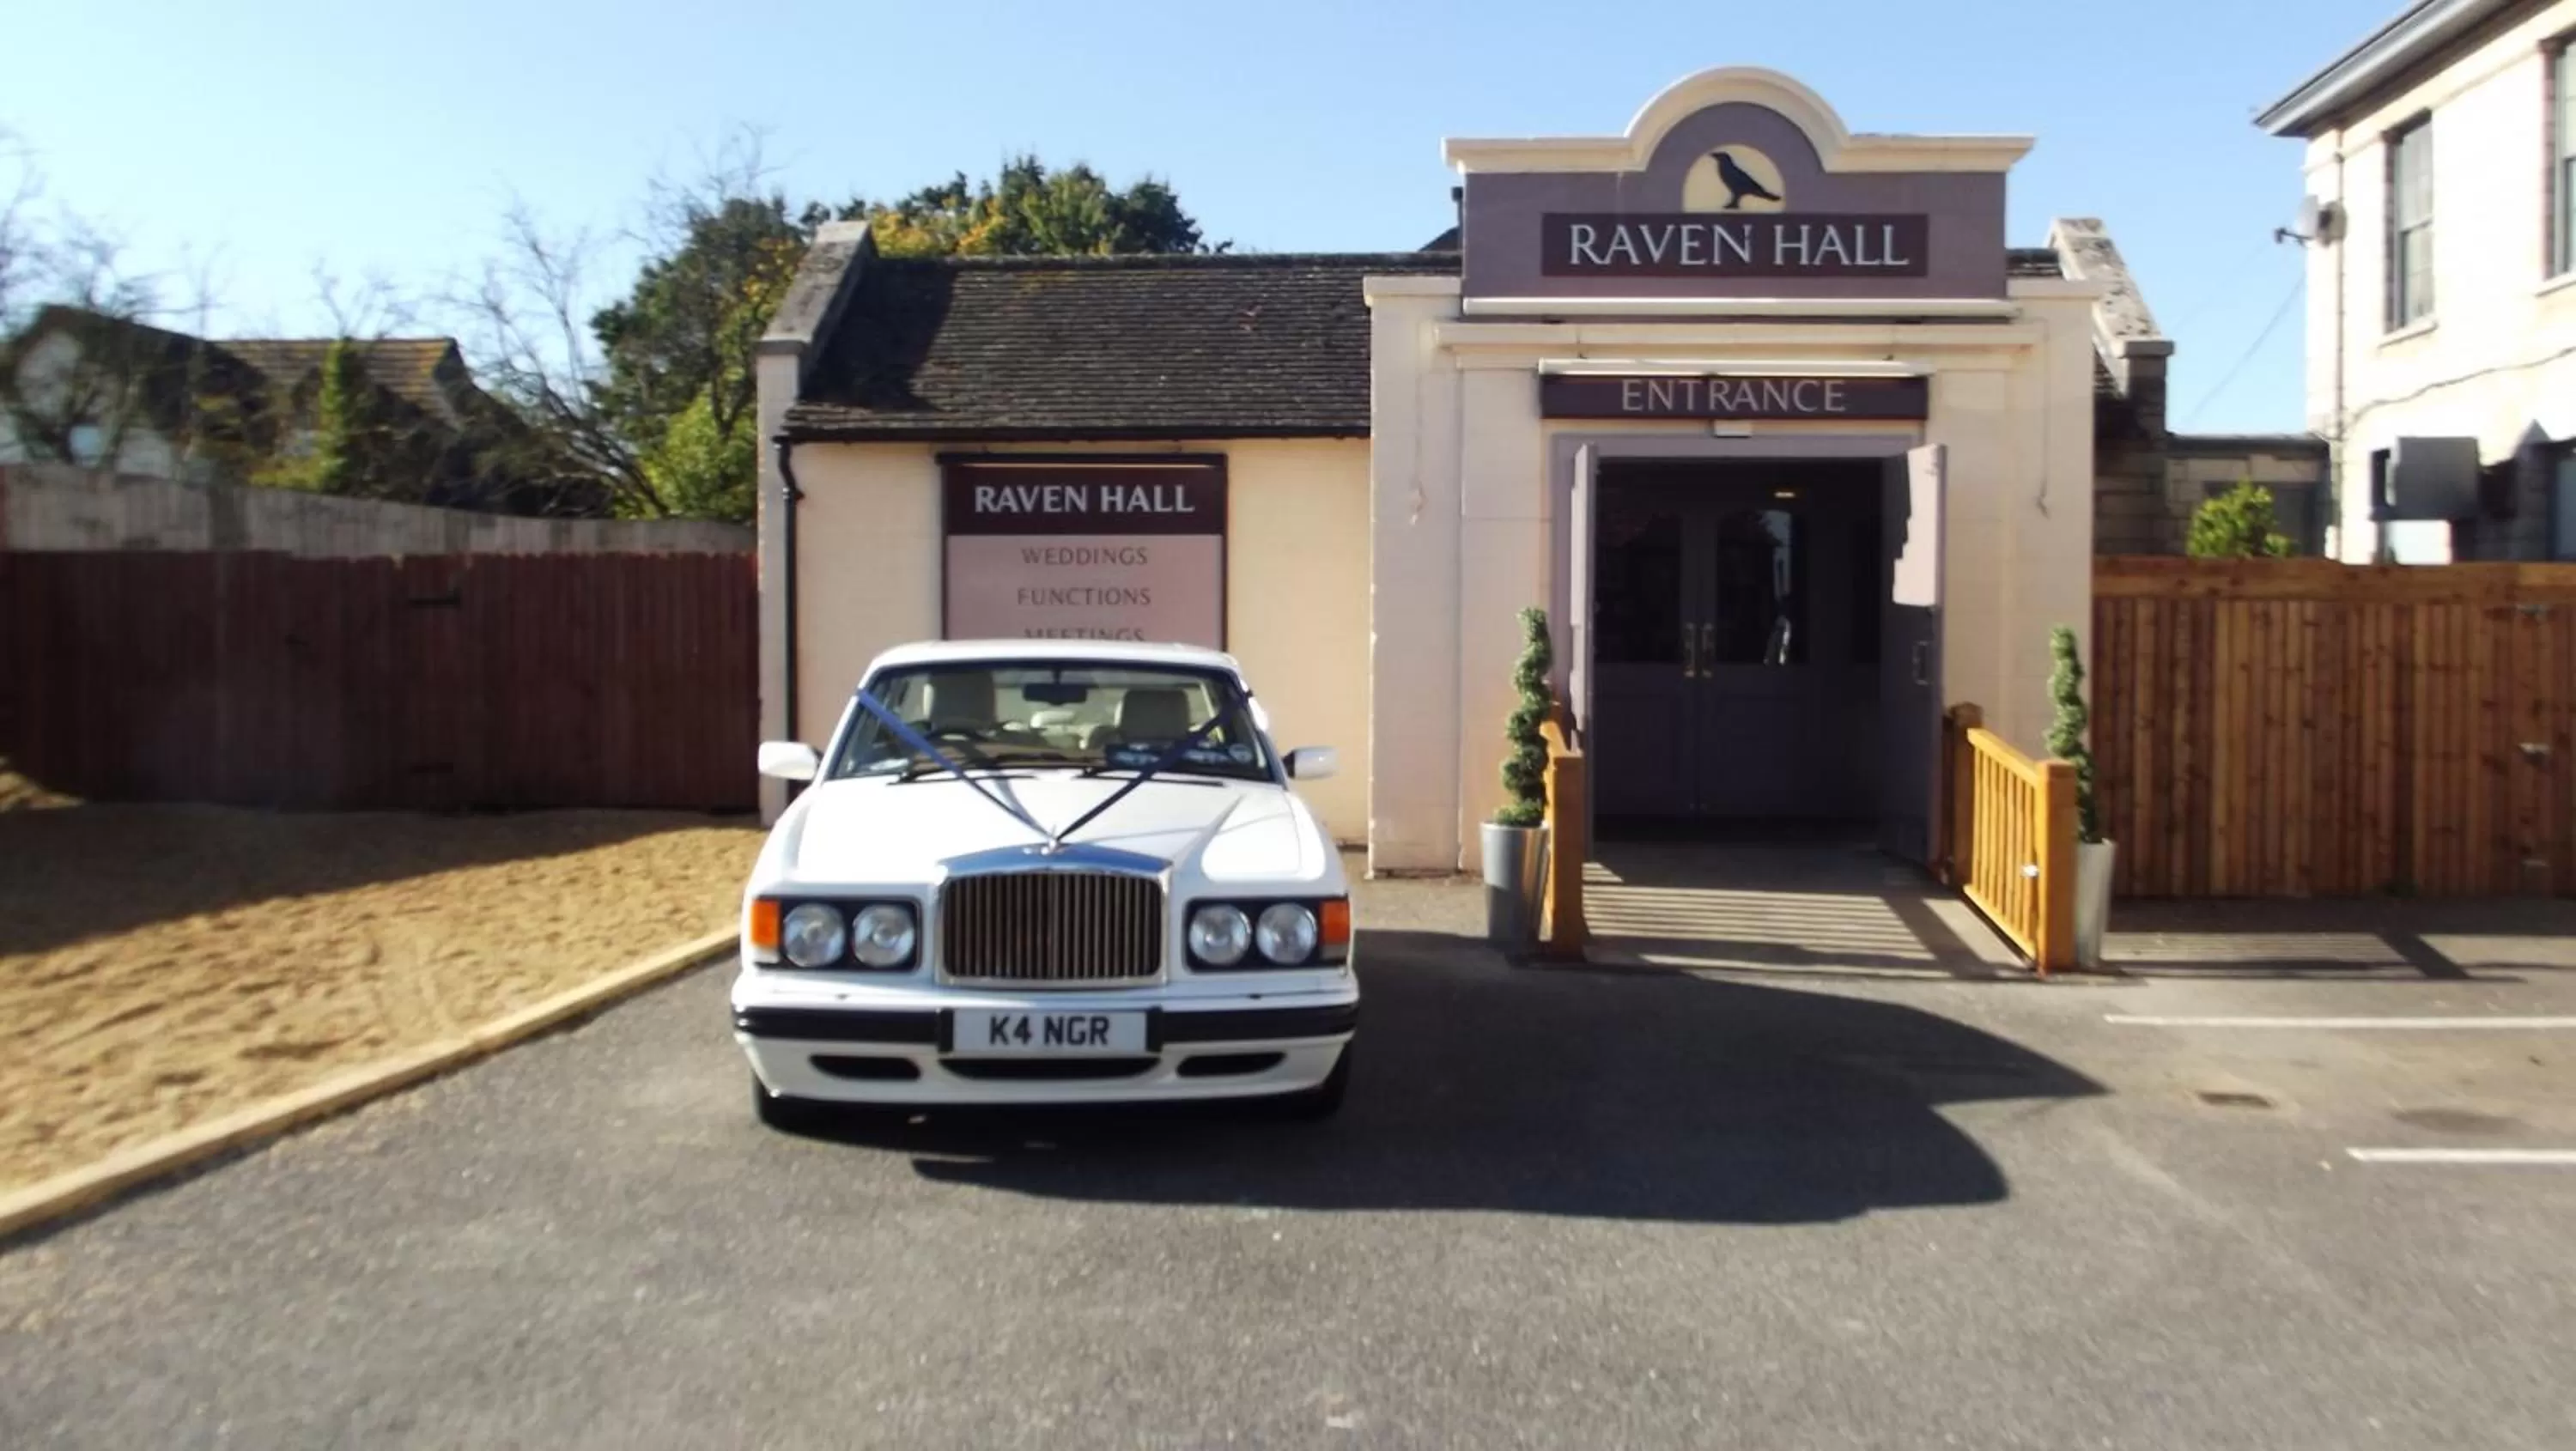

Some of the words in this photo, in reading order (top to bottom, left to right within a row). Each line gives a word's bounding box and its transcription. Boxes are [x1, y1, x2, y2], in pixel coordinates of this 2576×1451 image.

[1570, 224, 1751, 265] RAVEN
[1774, 224, 1909, 265] HALL
[1622, 379, 1846, 411] ENTRANCE
[975, 485, 1087, 513] RAVEN
[1101, 485, 1195, 513] HALL
[1021, 546, 1149, 567] WEDDINGS
[1017, 587, 1151, 607] FUNCTIONS
[989, 1014, 1032, 1047] K4
[1043, 1014, 1110, 1047] NGR
